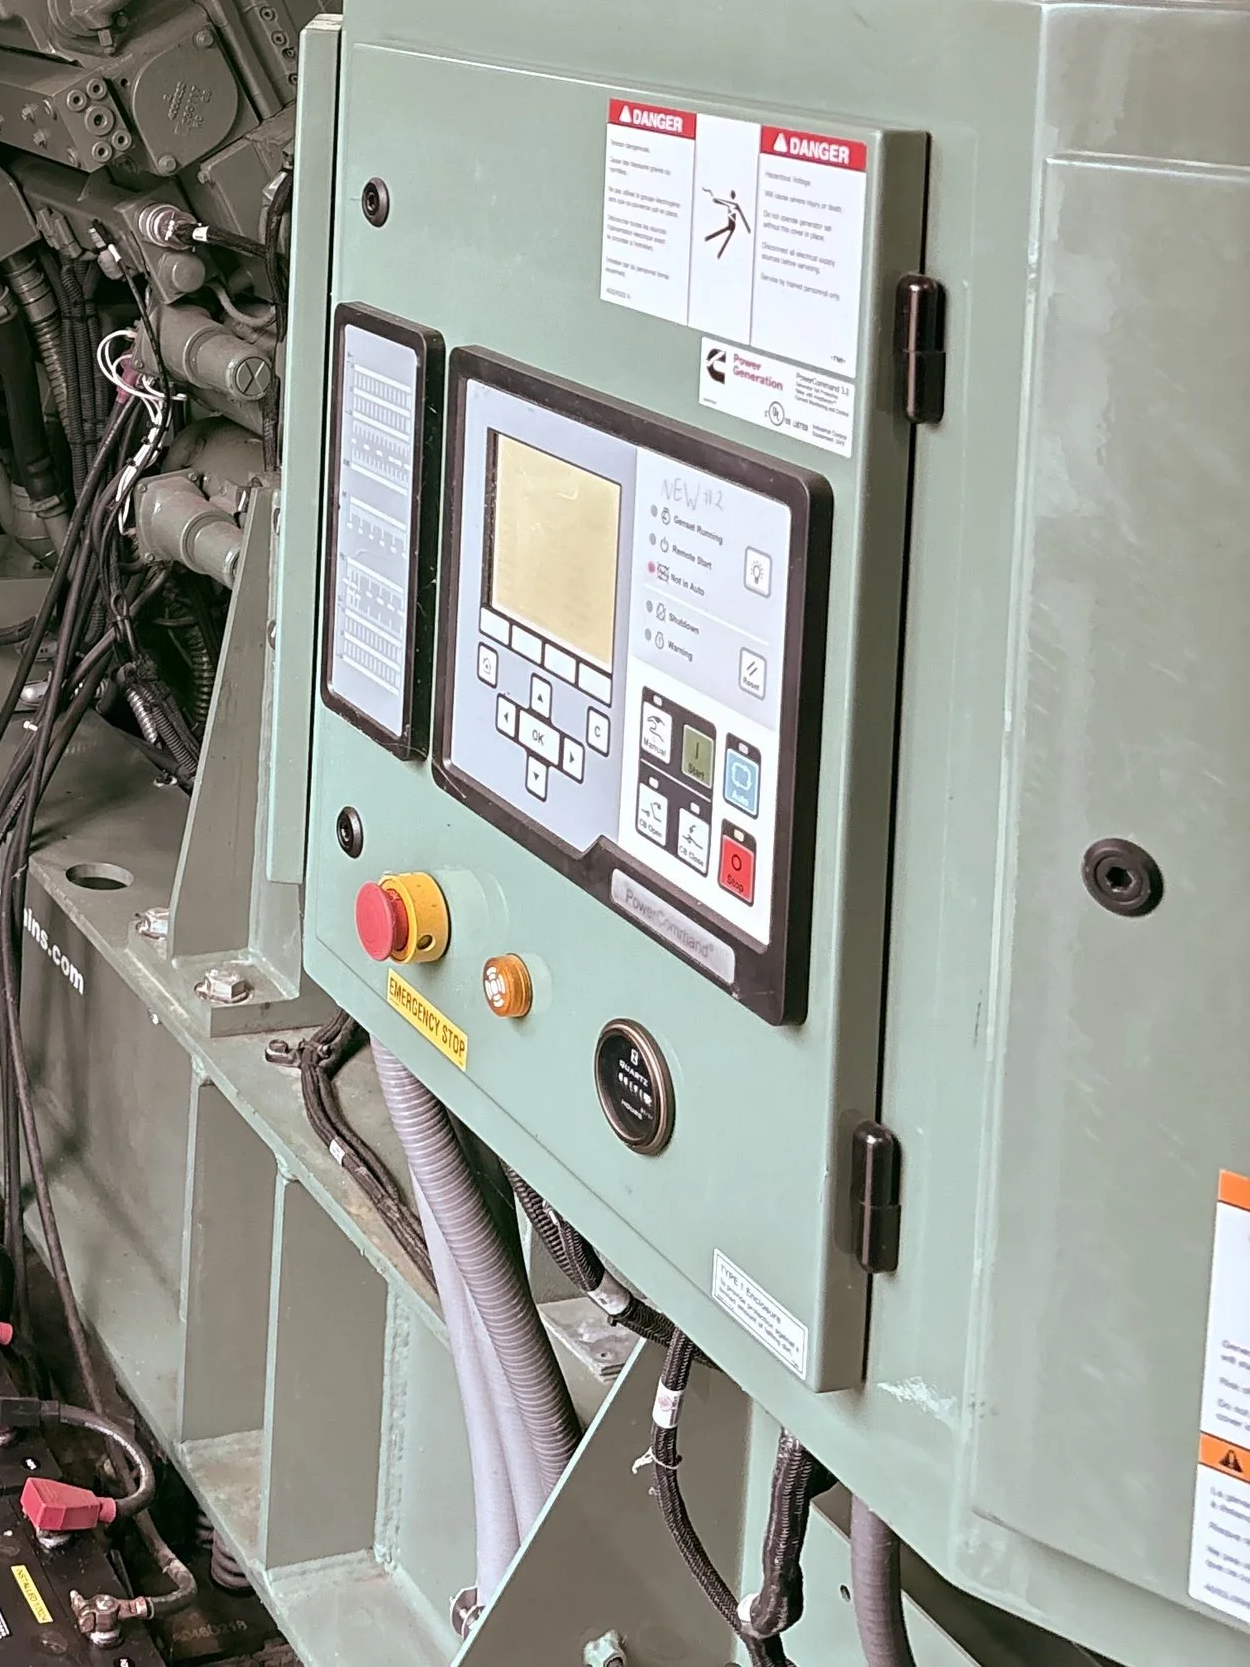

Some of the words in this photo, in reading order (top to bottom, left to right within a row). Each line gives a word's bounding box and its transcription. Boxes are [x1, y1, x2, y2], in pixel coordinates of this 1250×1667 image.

[633, 109, 683, 133] DANGER
[790, 136, 849, 164] DANGER
[733, 353, 761, 371] Power
[733, 365, 783, 391] Generation
[661, 478, 700, 510] NEW
[674, 515, 695, 532] Genset
[697, 526, 723, 545] Running
[672, 545, 695, 563] Remote
[697, 555, 712, 569] Start
[671, 574, 682, 585] Not
[683, 578, 689, 589] in
[690, 582, 705, 596] Auto
[669, 613, 699, 634] Shutdown
[668, 640, 693, 662] Warning
[743, 677, 760, 691] Reset
[532, 729, 544, 745] OK
[594, 726, 601, 737] C
[644, 737, 667, 758] Manual
[688, 763, 705, 780] Start
[727, 874, 744, 893] Stop
[390, 977, 440, 1036] EMERGENCY
[442, 1025, 465, 1057] STOP
[619, 1059, 648, 1087] QUARTZ
[621, 1099, 642, 1120] HOURS
[720, 1263, 738, 1287] TYPE
